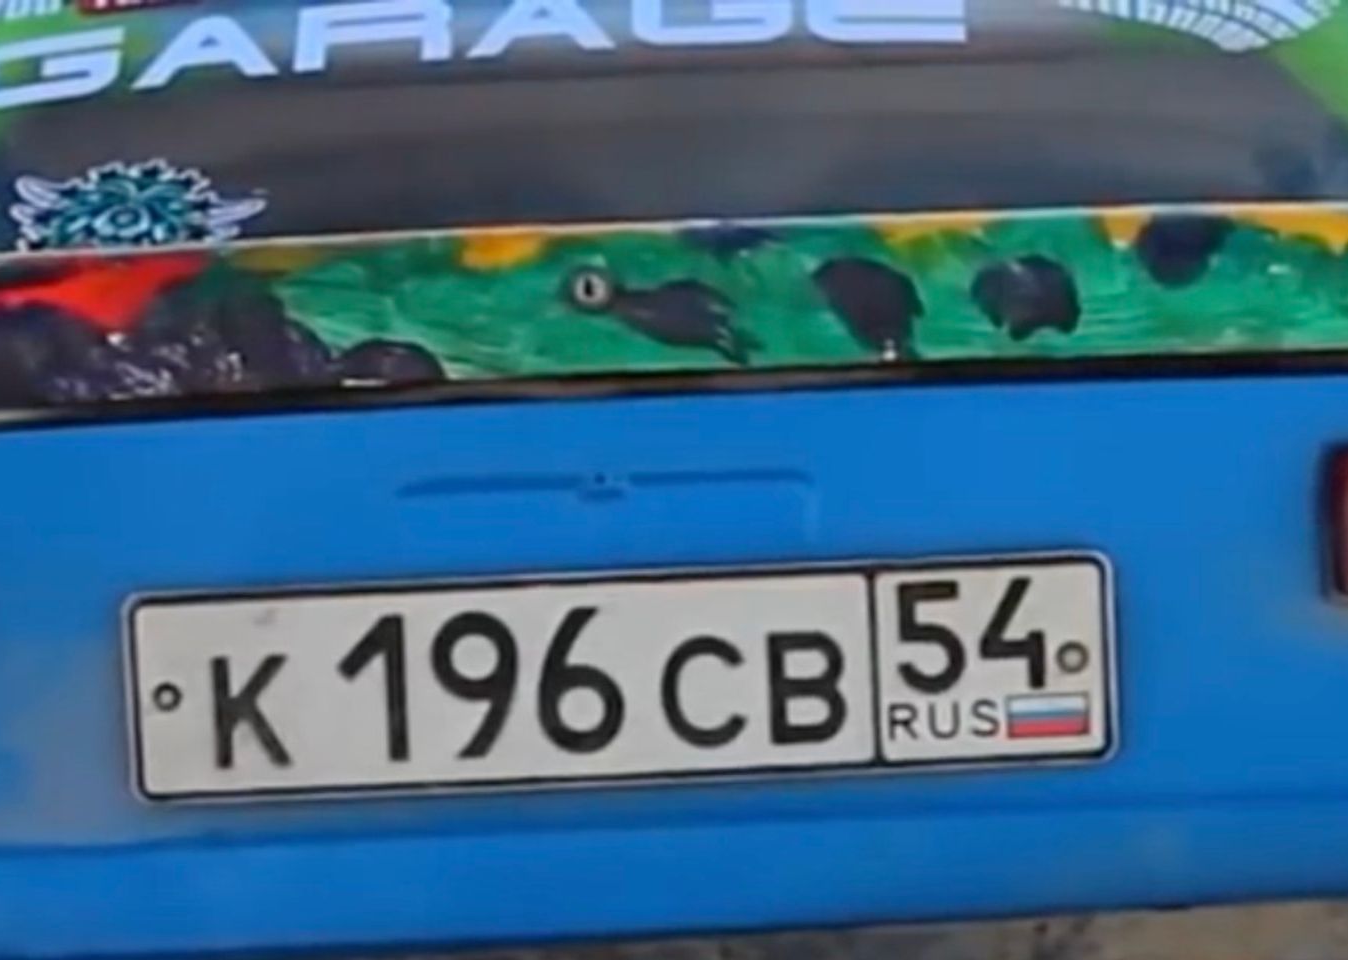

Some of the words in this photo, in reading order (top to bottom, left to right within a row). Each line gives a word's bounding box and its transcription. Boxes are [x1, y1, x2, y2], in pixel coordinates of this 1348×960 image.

[336, 605, 627, 762] 196
[897, 576, 1046, 696] 54
[887, 698, 1000, 741] RUS
